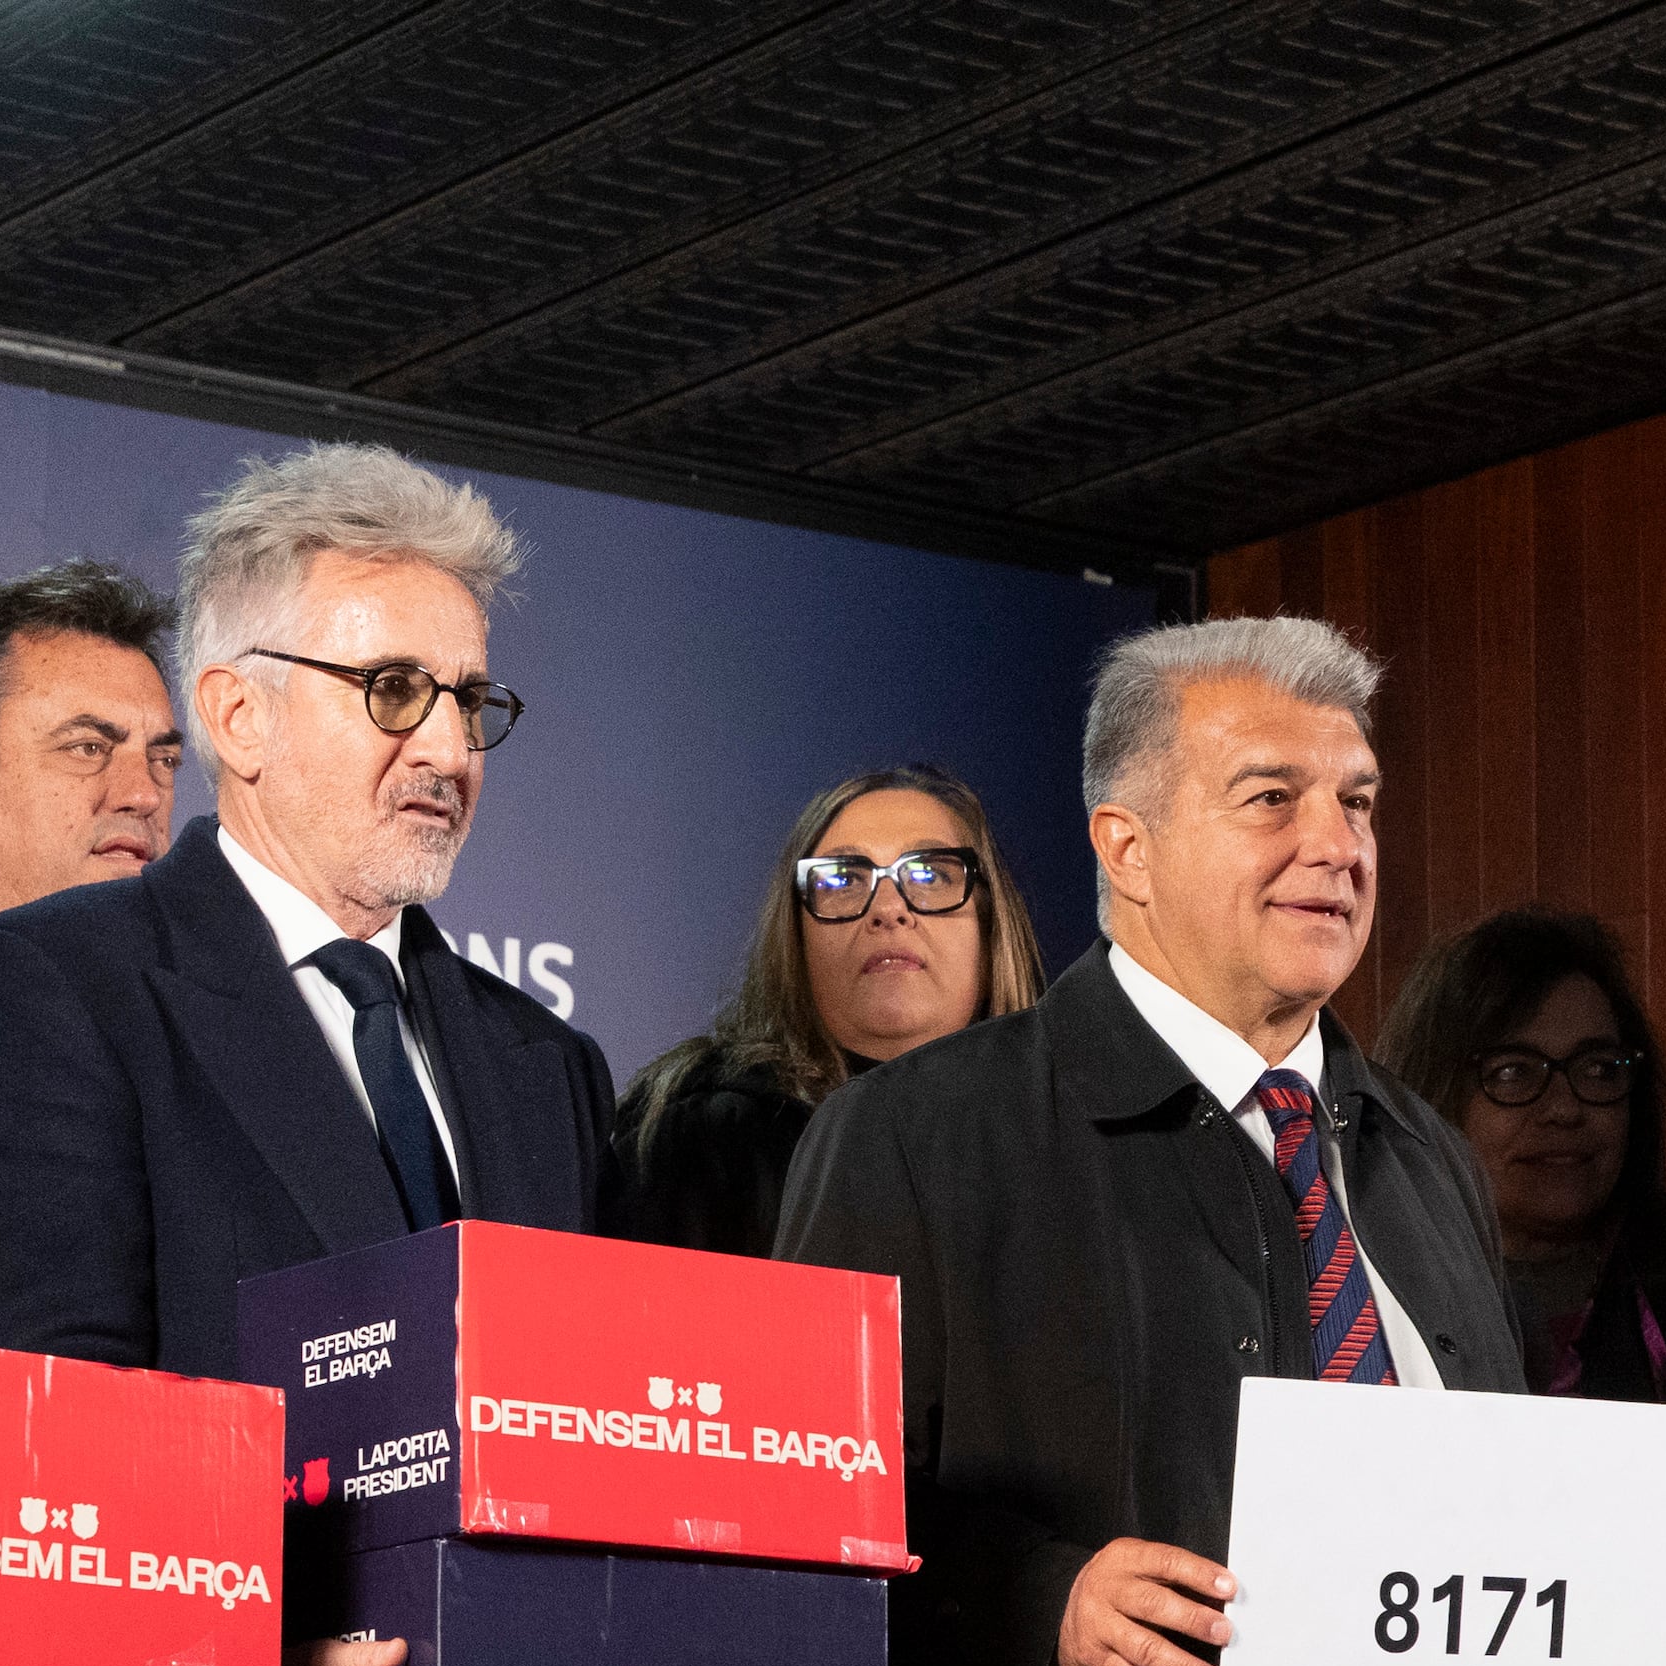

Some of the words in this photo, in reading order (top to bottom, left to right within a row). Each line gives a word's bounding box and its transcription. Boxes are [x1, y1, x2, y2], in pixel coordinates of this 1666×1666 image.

[301, 1318, 396, 1364] DEFENSEM
[305, 1363, 328, 1388] EL
[329, 1347, 392, 1382] BARÇA
[358, 1428, 451, 1472] LAPORTA
[470, 1395, 691, 1454] DEFENSEM
[697, 1420, 747, 1460] EL
[753, 1426, 888, 1482] BARÇA
[343, 1456, 451, 1501] PRESIDENT
[70, 1544, 123, 1587] EL
[129, 1551, 272, 1611] BARÇA
[1374, 1571, 1567, 1659] 8171
